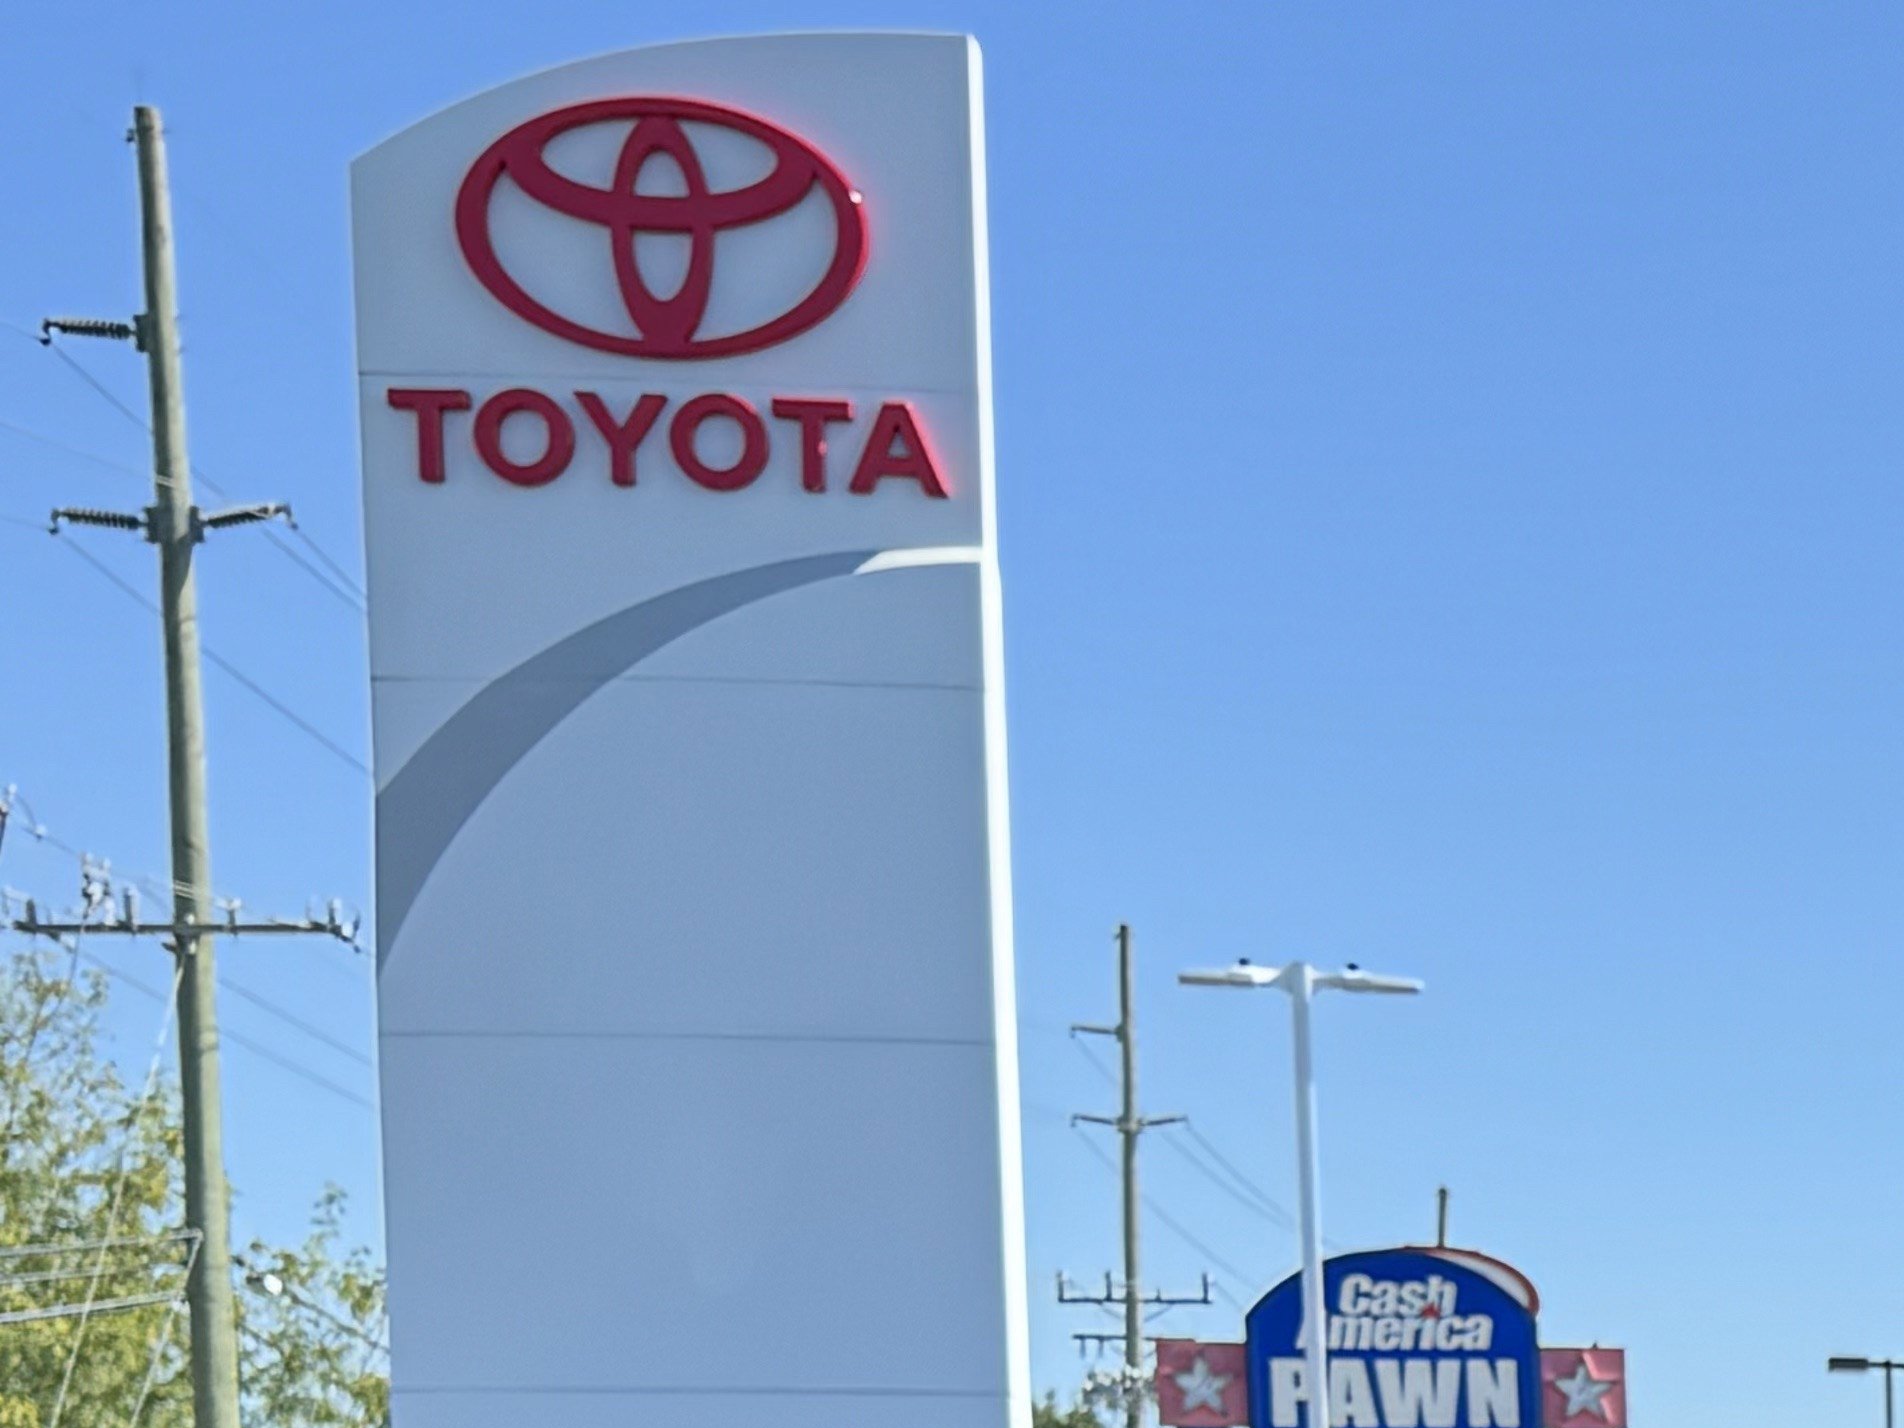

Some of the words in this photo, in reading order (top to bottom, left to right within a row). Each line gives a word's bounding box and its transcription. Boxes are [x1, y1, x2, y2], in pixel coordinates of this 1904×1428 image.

[387, 387, 949, 499] TOYOTA
[1339, 1273, 1457, 1317] Cash
[1269, 1356, 1520, 1428] PAWN
